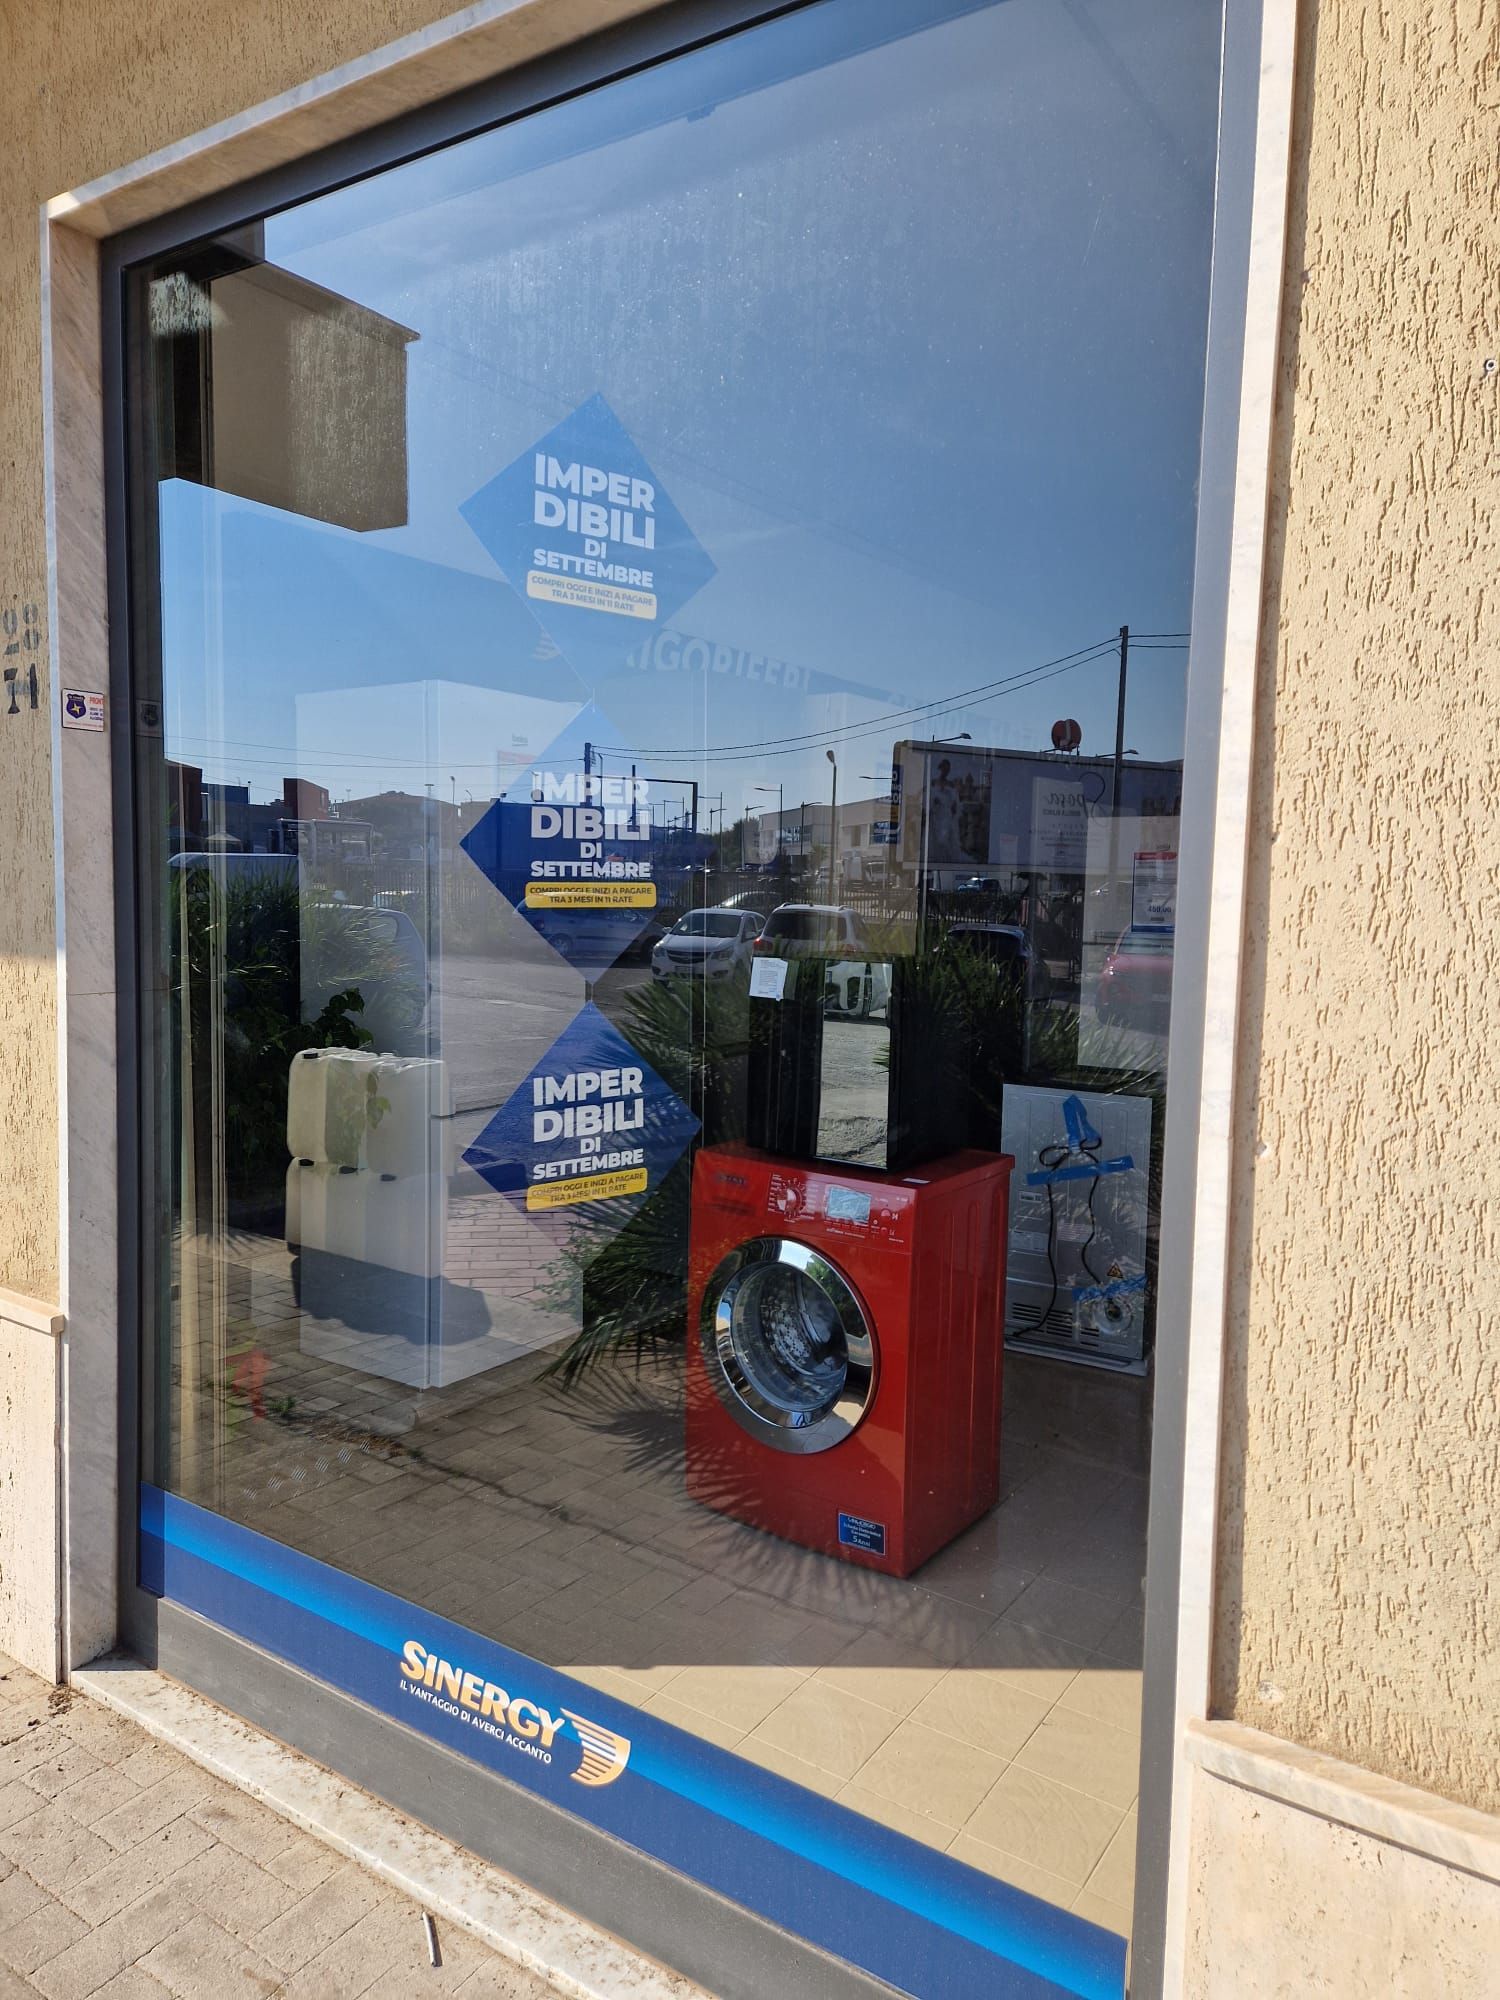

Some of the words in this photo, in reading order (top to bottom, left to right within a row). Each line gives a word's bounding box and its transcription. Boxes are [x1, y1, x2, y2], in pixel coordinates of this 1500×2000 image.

[535, 453, 655, 513] IMPER
[534, 490, 655, 550] DIBILI
[584, 538, 606, 559] DI
[533, 548, 654, 588] SETTEMBRE
[531, 575, 565, 590] COMPRI
[566, 582, 587, 594] OGGI
[587, 586, 593, 594] E
[595, 587, 614, 599] INIZI
[614, 591, 621, 599] A
[621, 593, 653, 606] PAGARE
[551, 588, 568, 600] TRA
[569, 591, 575, 600] 3
[576, 592, 596, 604] MESI
[597, 596, 605, 605] IN
[614, 599, 635, 612] RATE
[532, 771, 650, 806] IMPER
[531, 806, 650, 841] DIBILI
[580, 843, 602, 859] DI
[531, 861, 651, 878] SETTEMBRE
[530, 887, 562, 895] COMPRI
[592, 887, 611, 895] INIZI
[620, 887, 651, 895] PAGARE
[533, 1066, 643, 1106] IMPER
[533, 1098, 644, 1143] DIBILI
[580, 1137, 601, 1155] DI
[532, 1149, 644, 1180] SETTEMBRE
[563, 1182, 583, 1192] OGGI
[590, 1179, 607, 1188] INIZI
[615, 1172, 644, 1183] PAGARE
[608, 1183, 627, 1194] RATE
[400, 1640, 565, 1747] SINERGY
[400, 1679, 408, 1691] IL
[409, 1684, 459, 1717] VANTAGGIO
[461, 1710, 471, 1722] DI
[472, 1716, 505, 1741] AVERCI
[505, 1733, 552, 1764] ACCANTO
